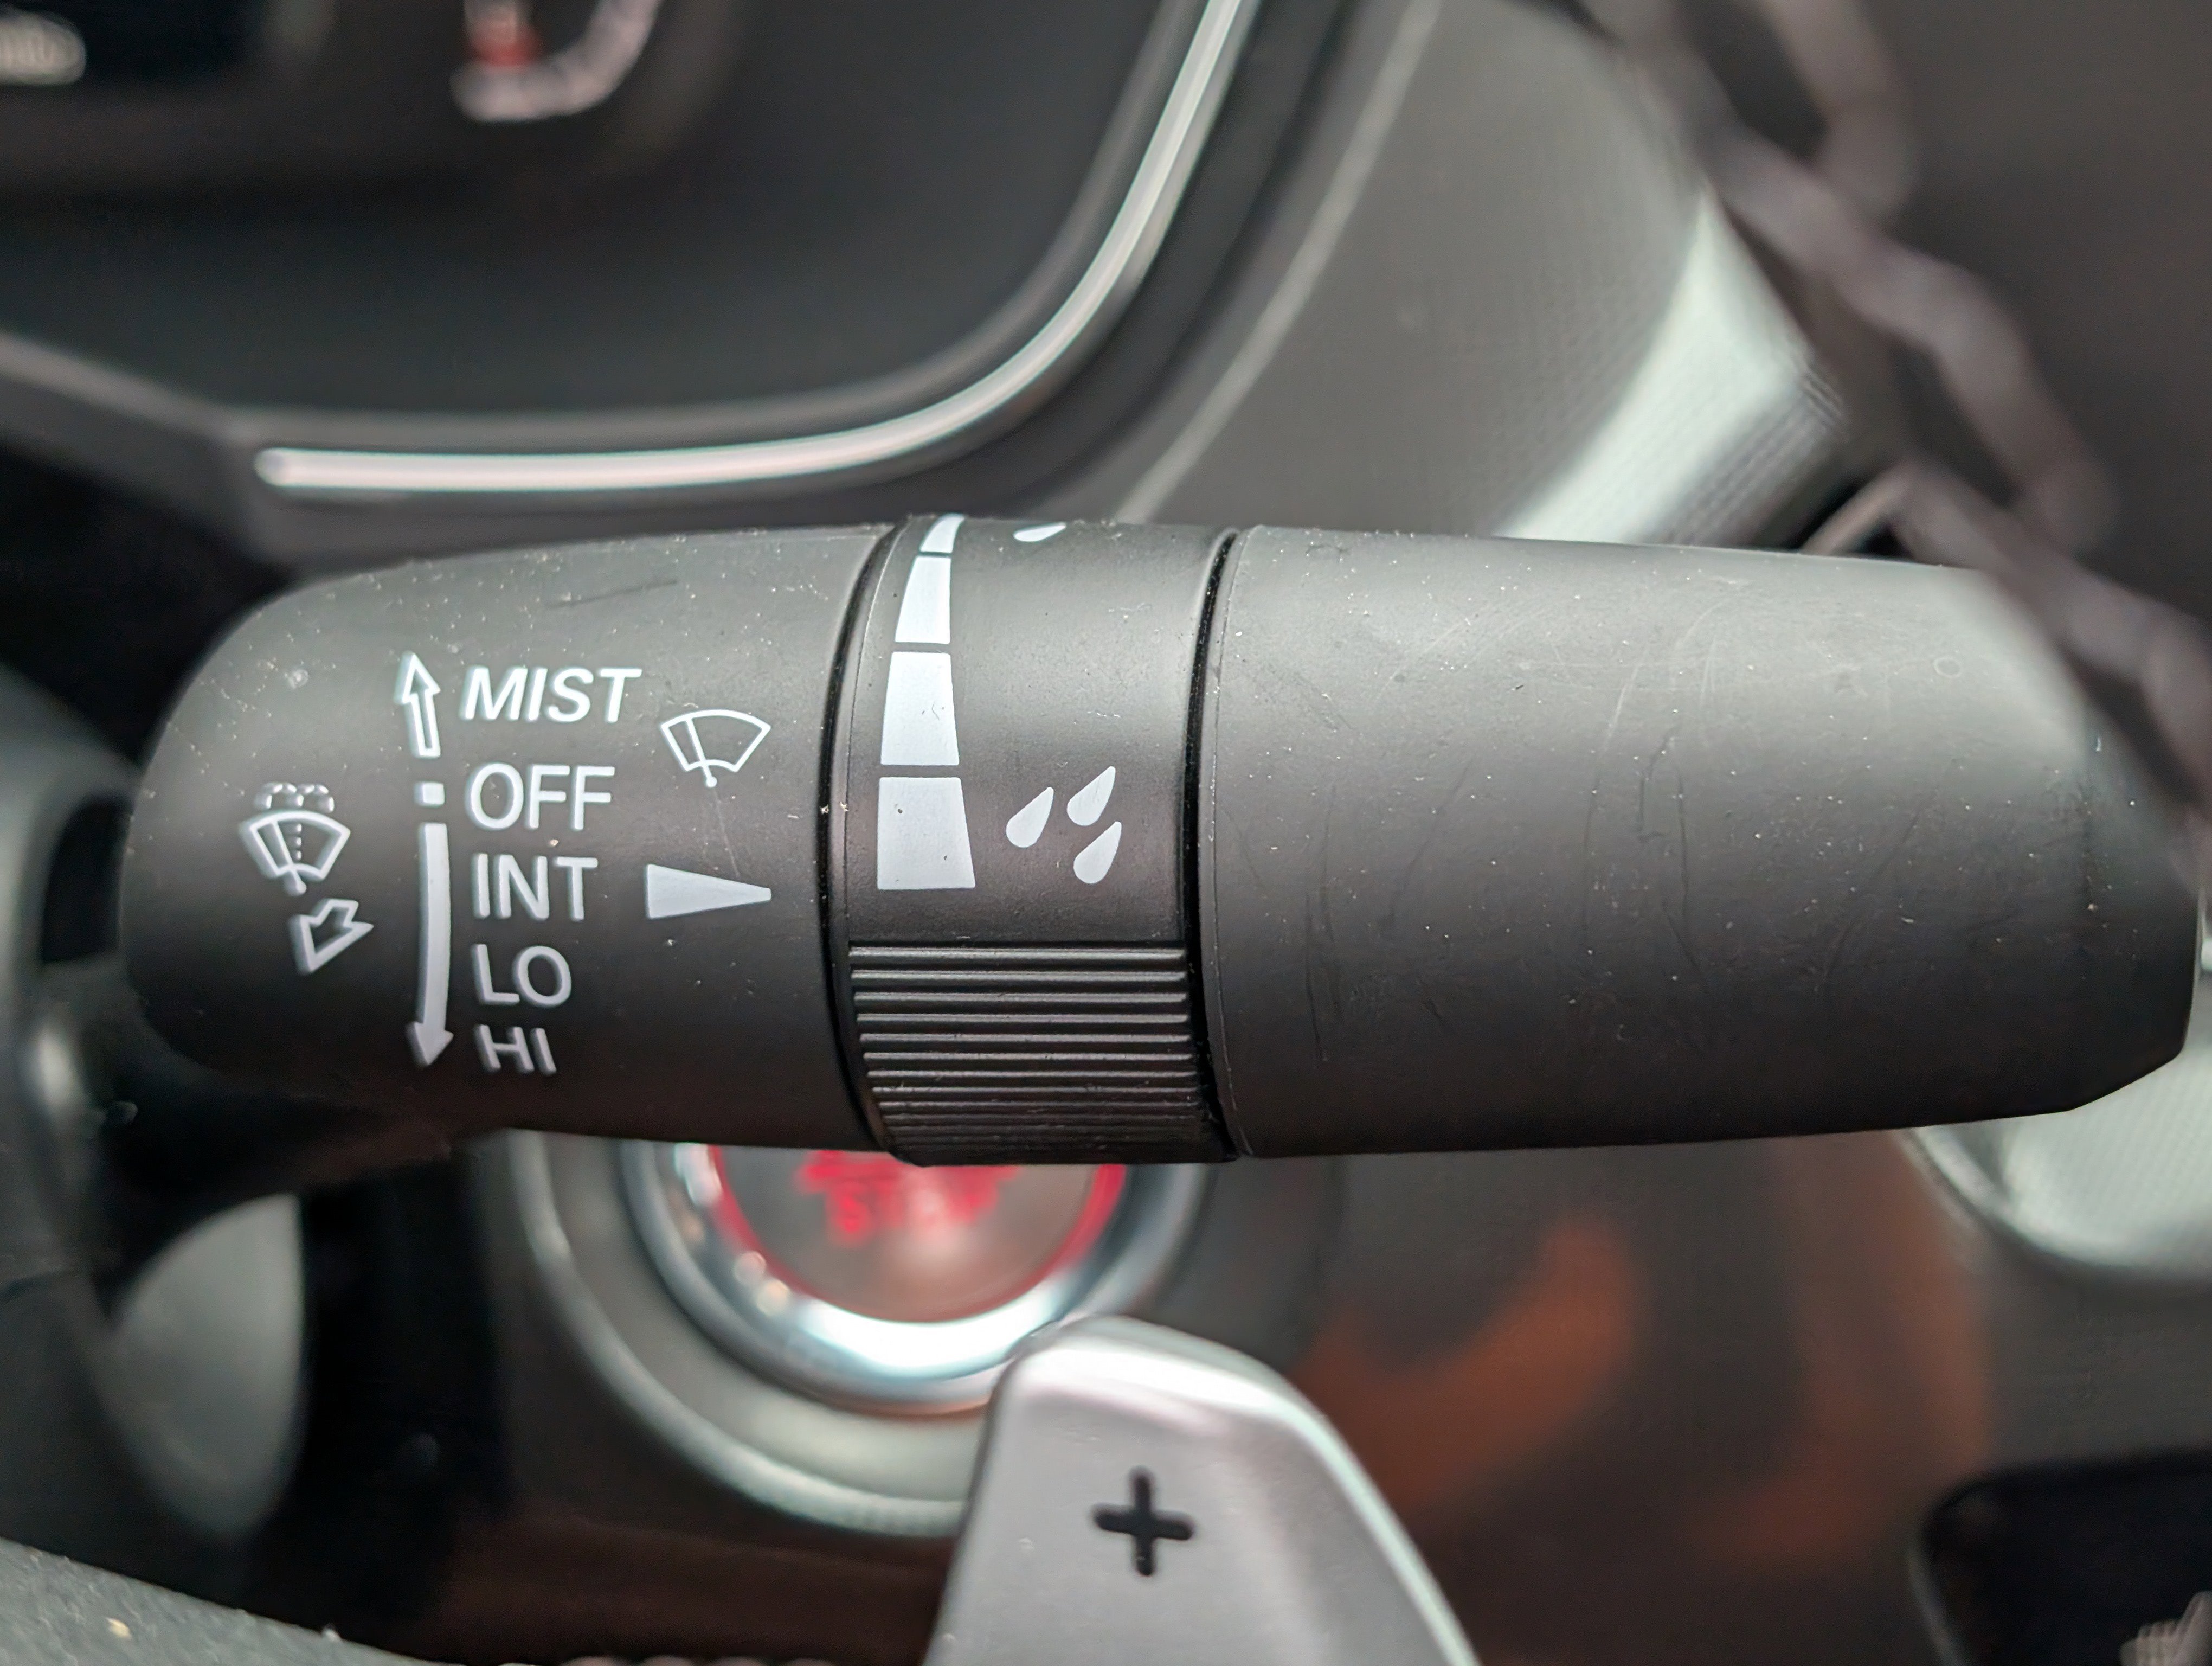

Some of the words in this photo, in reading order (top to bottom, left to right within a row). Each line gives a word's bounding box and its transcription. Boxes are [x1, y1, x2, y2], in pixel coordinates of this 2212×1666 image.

[460, 666, 642, 723] MIST
[465, 762, 615, 831] OFF
[472, 853, 598, 921] INT
[472, 944, 571, 1006] LO
[473, 1024, 557, 1075] HI
